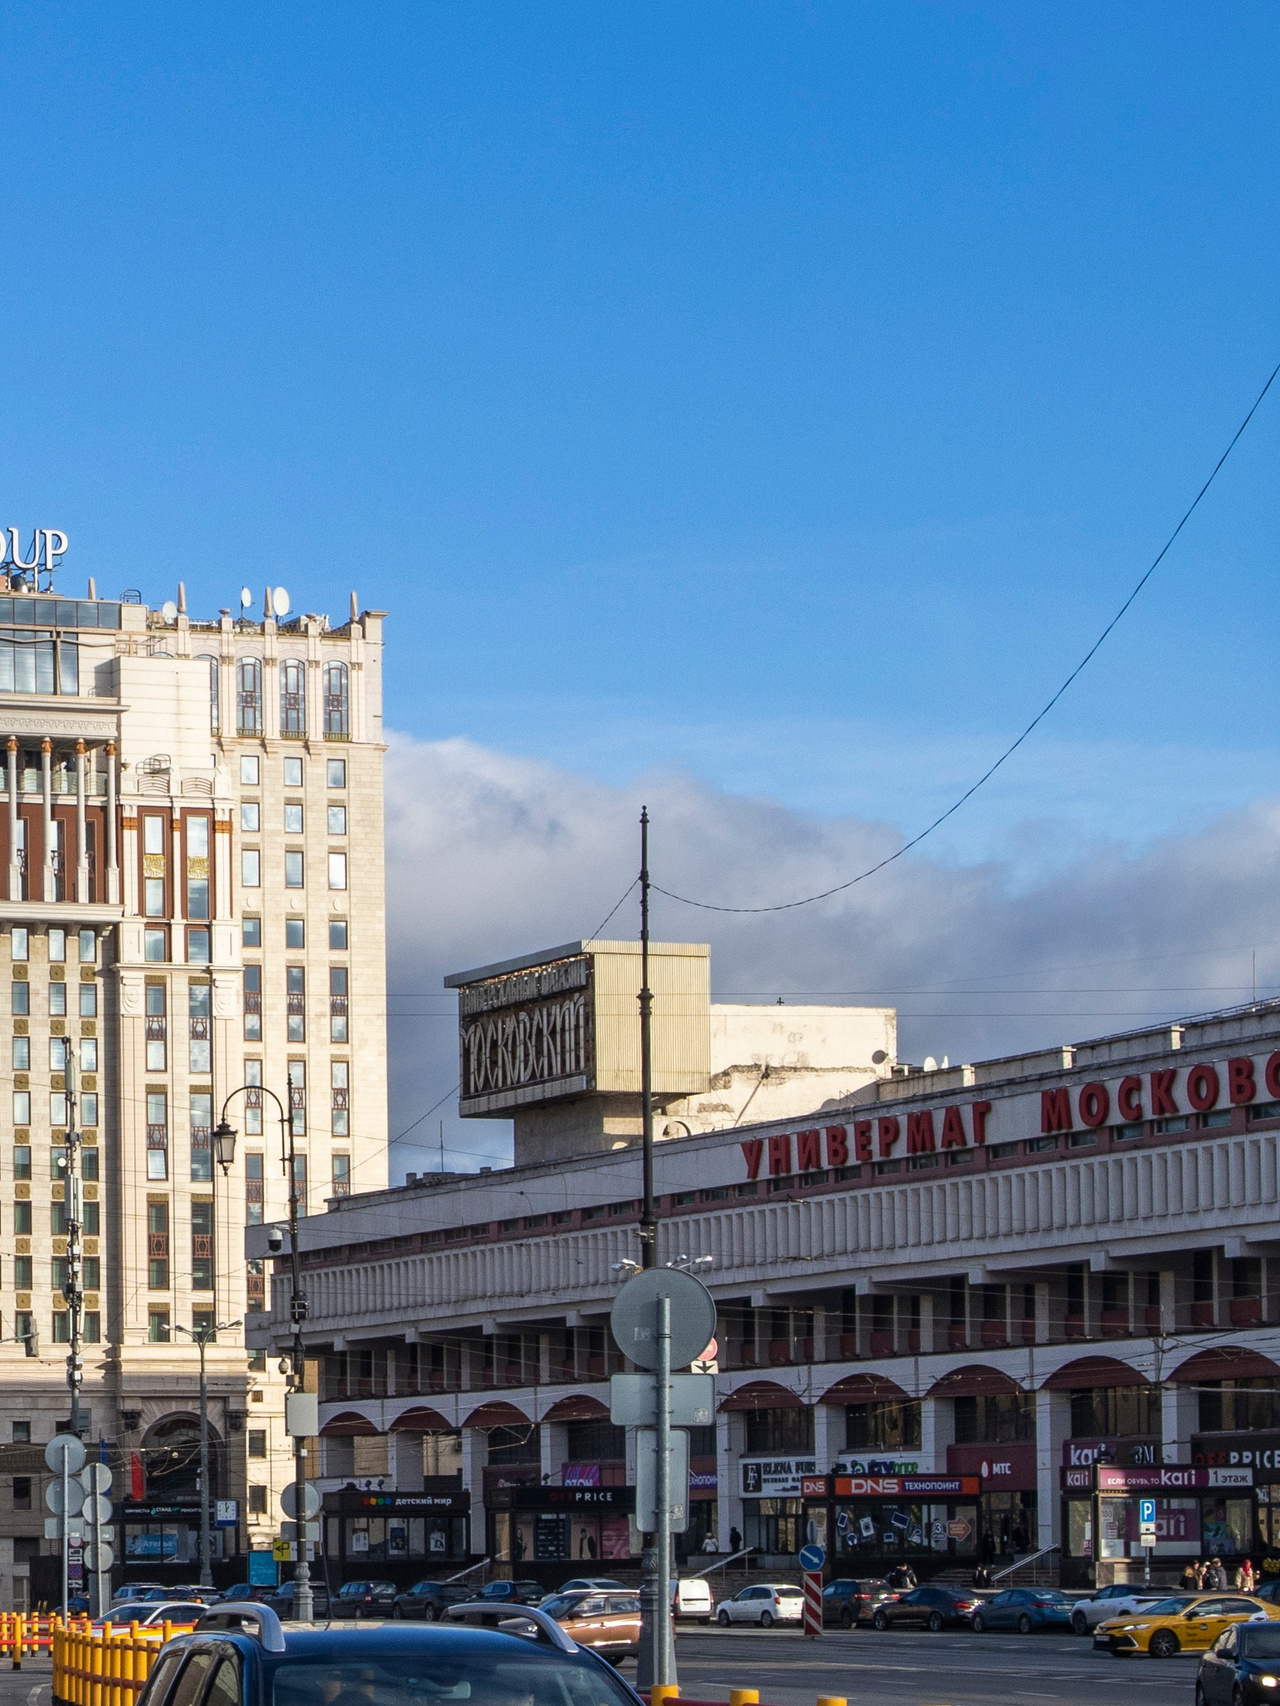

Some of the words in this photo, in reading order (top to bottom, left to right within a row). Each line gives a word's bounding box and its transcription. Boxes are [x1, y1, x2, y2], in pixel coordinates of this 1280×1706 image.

[460, 993, 585, 1094] МОСКОВСКИЙ
[740, 1100, 992, 1179] УНИВЕРМАГ
[992, 1462, 1011, 1475] МТС
[1067, 1470, 1089, 1486] kari
[1107, 1477, 1125, 1485] ЕСЛИ
[1161, 1469, 1196, 1485] kari
[1212, 1470, 1219, 1484] 1
[1221, 1474, 1249, 1484] этаж
[803, 1481, 825, 1493] DNS
[851, 1479, 899, 1494] DNS
[904, 1481, 960, 1491] ТЕХНОПОИНТ
[395, 1496, 433, 1506] детский
[434, 1498, 452, 1507] мир
[1144, 1502, 1152, 1520] P
[1156, 1514, 1186, 1536] ari
